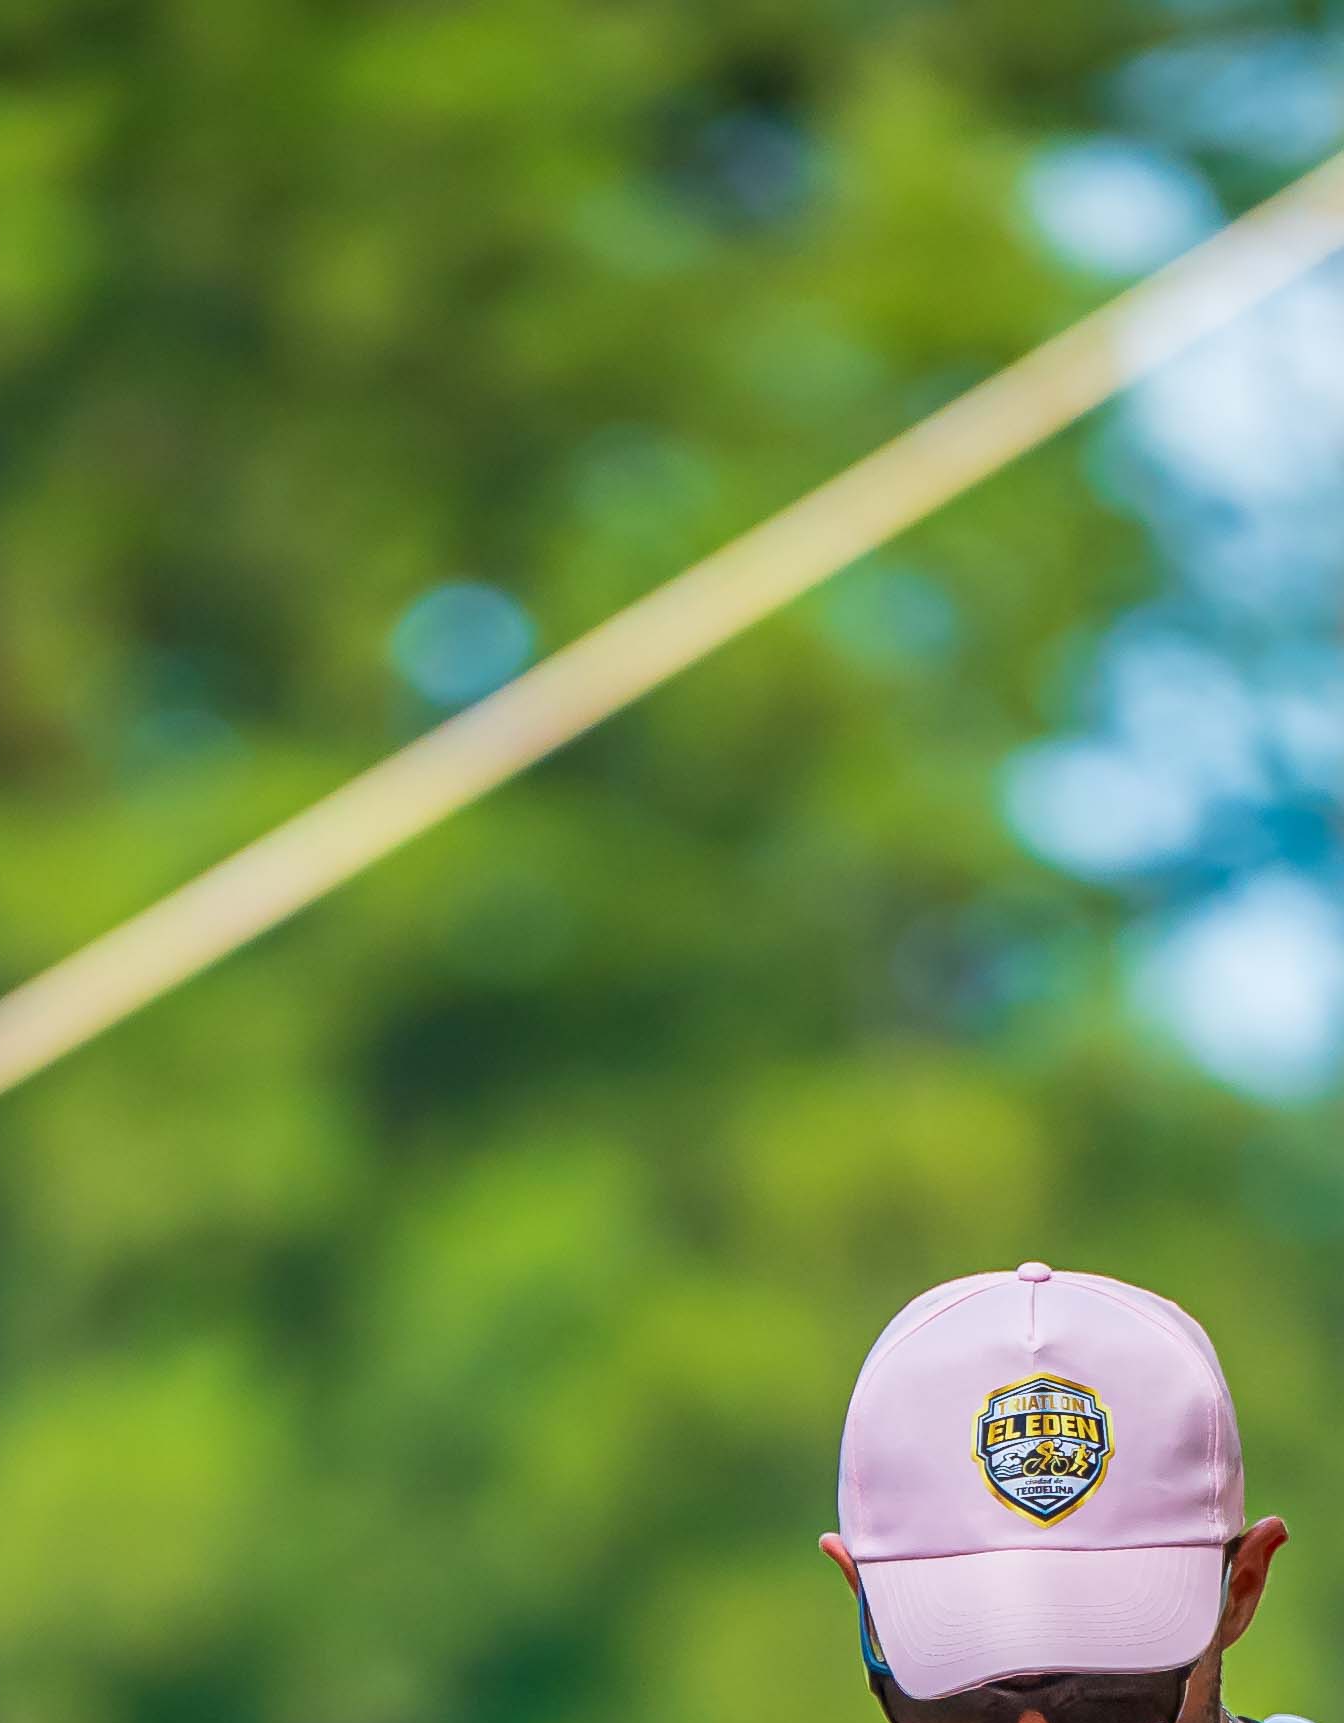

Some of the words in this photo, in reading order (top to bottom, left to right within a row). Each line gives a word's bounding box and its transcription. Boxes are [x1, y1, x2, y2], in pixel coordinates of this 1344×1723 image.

[987, 1418, 1022, 1446] EL
[1025, 1414, 1100, 1443] EDEN
[1015, 1485, 1074, 1497] TEODELINA
